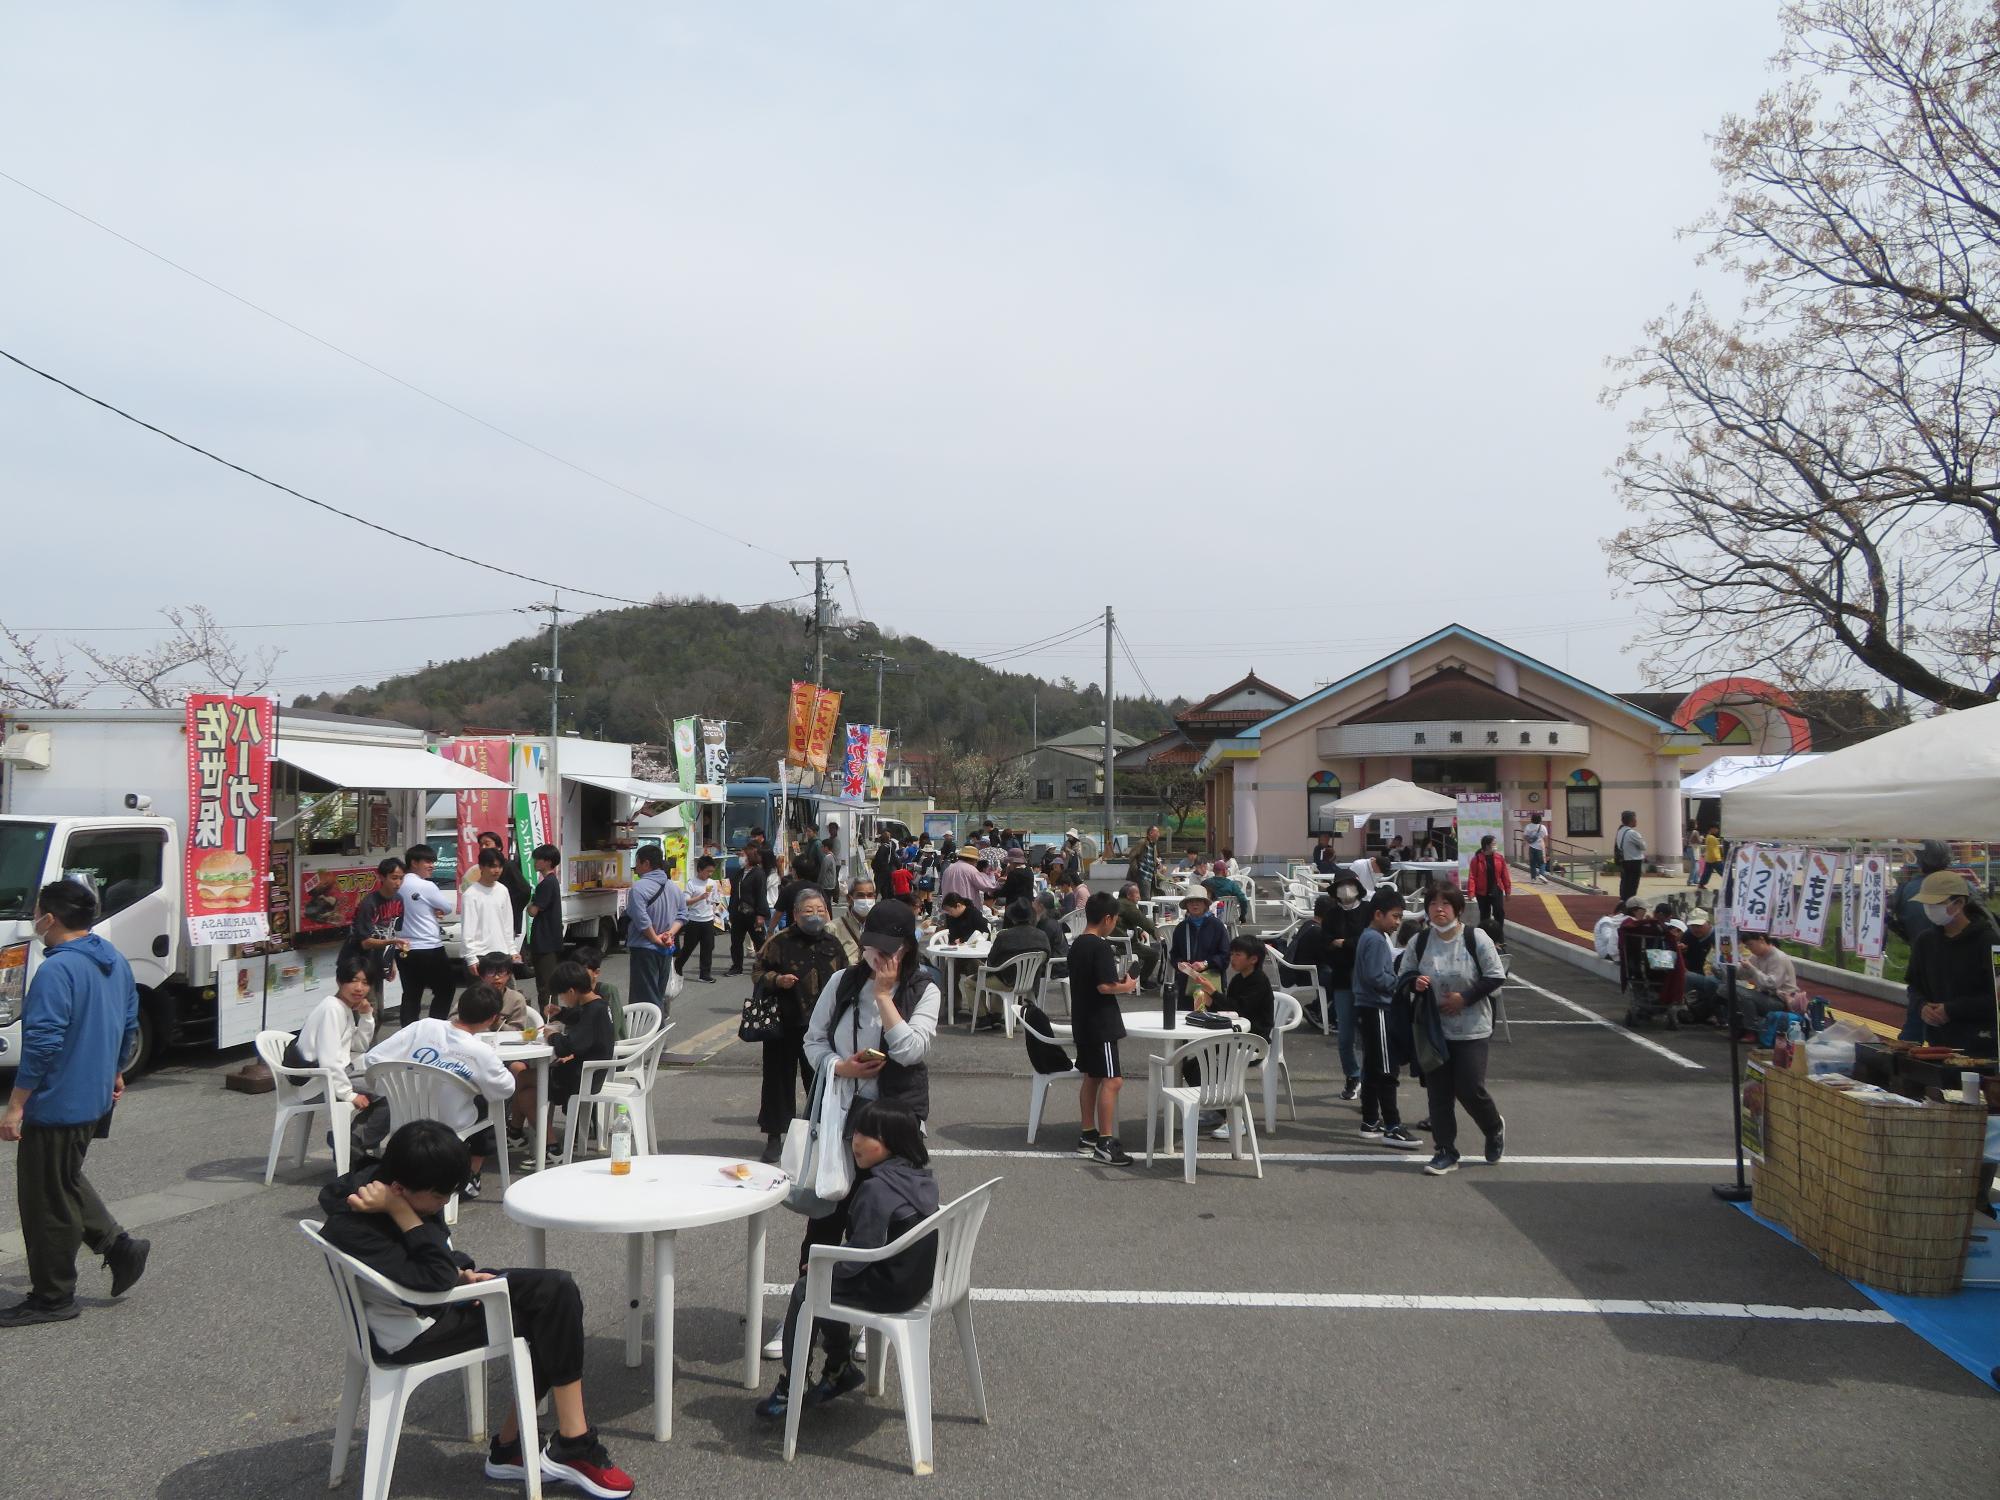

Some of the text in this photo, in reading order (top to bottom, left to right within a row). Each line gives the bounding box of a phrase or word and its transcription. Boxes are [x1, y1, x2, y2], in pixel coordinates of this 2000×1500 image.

[1747, 869, 1772, 915] つくね
[1804, 875, 1827, 921] もも
